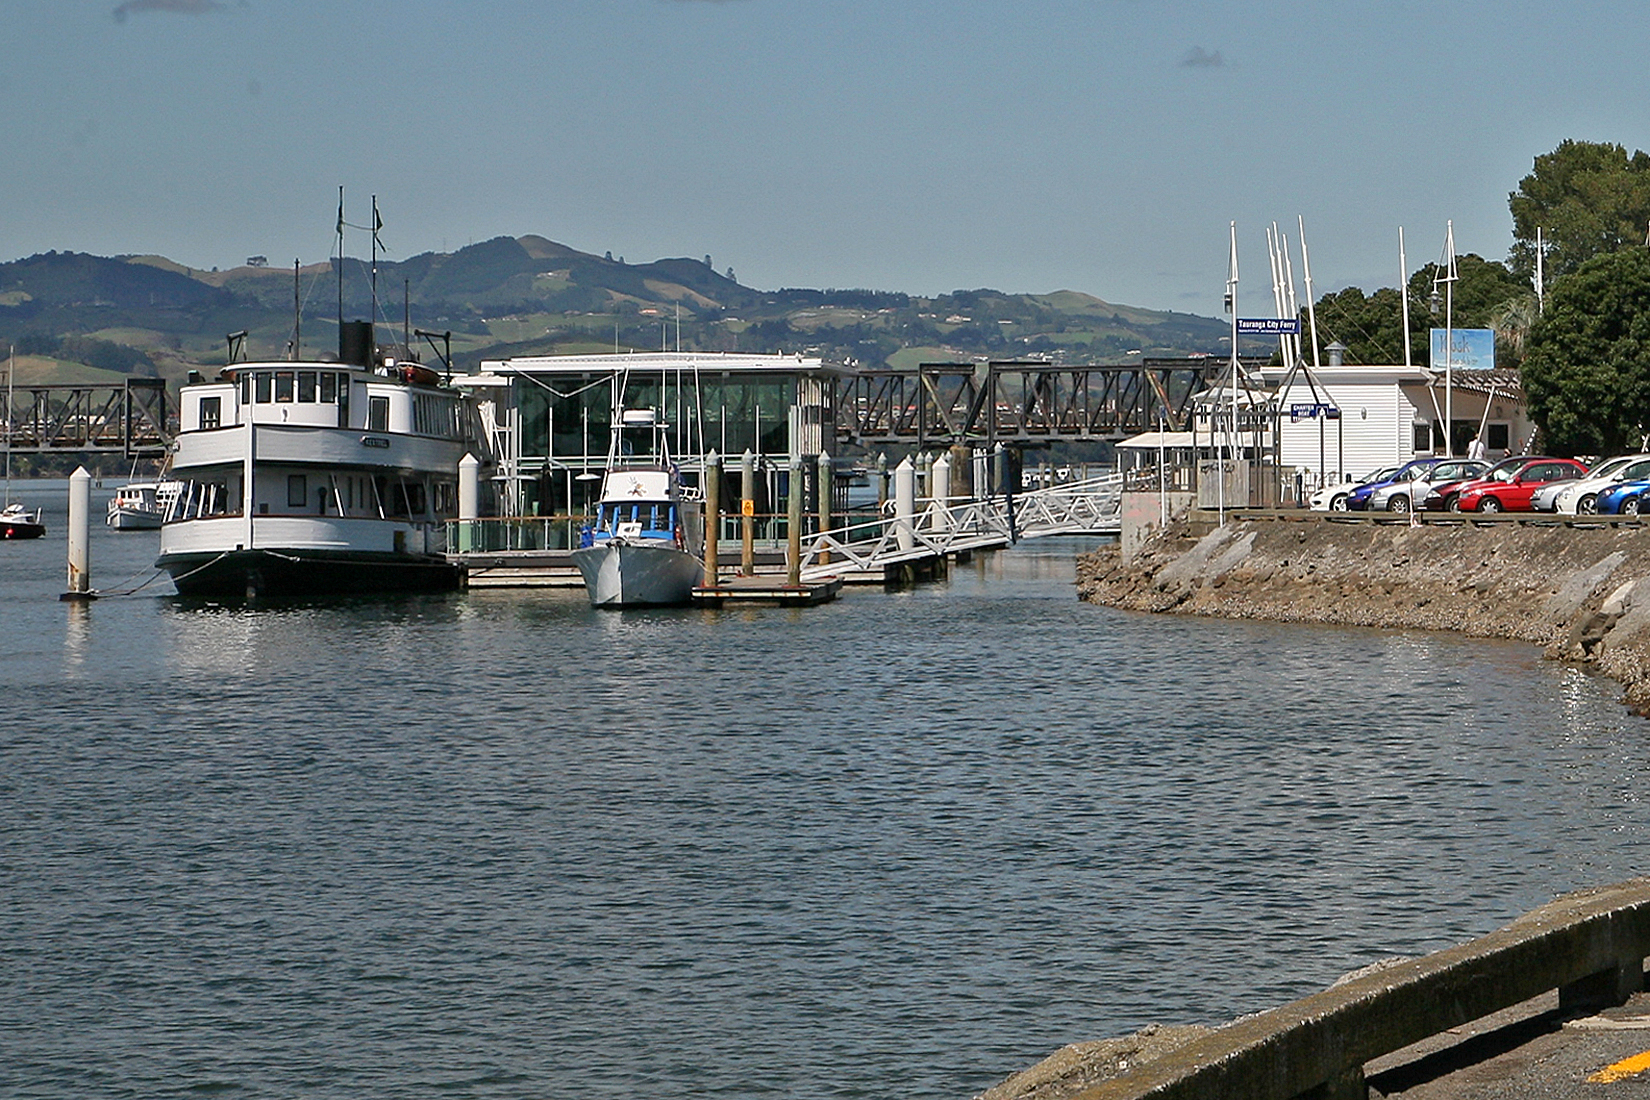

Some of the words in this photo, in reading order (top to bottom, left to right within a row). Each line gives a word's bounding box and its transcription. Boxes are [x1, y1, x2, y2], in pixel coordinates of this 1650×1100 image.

[1238, 320, 1266, 330] Tauranga
[1267, 320, 1279, 330] City
[1280, 320, 1296, 330] Ferry
[1439, 334, 1470, 353] Kosk
